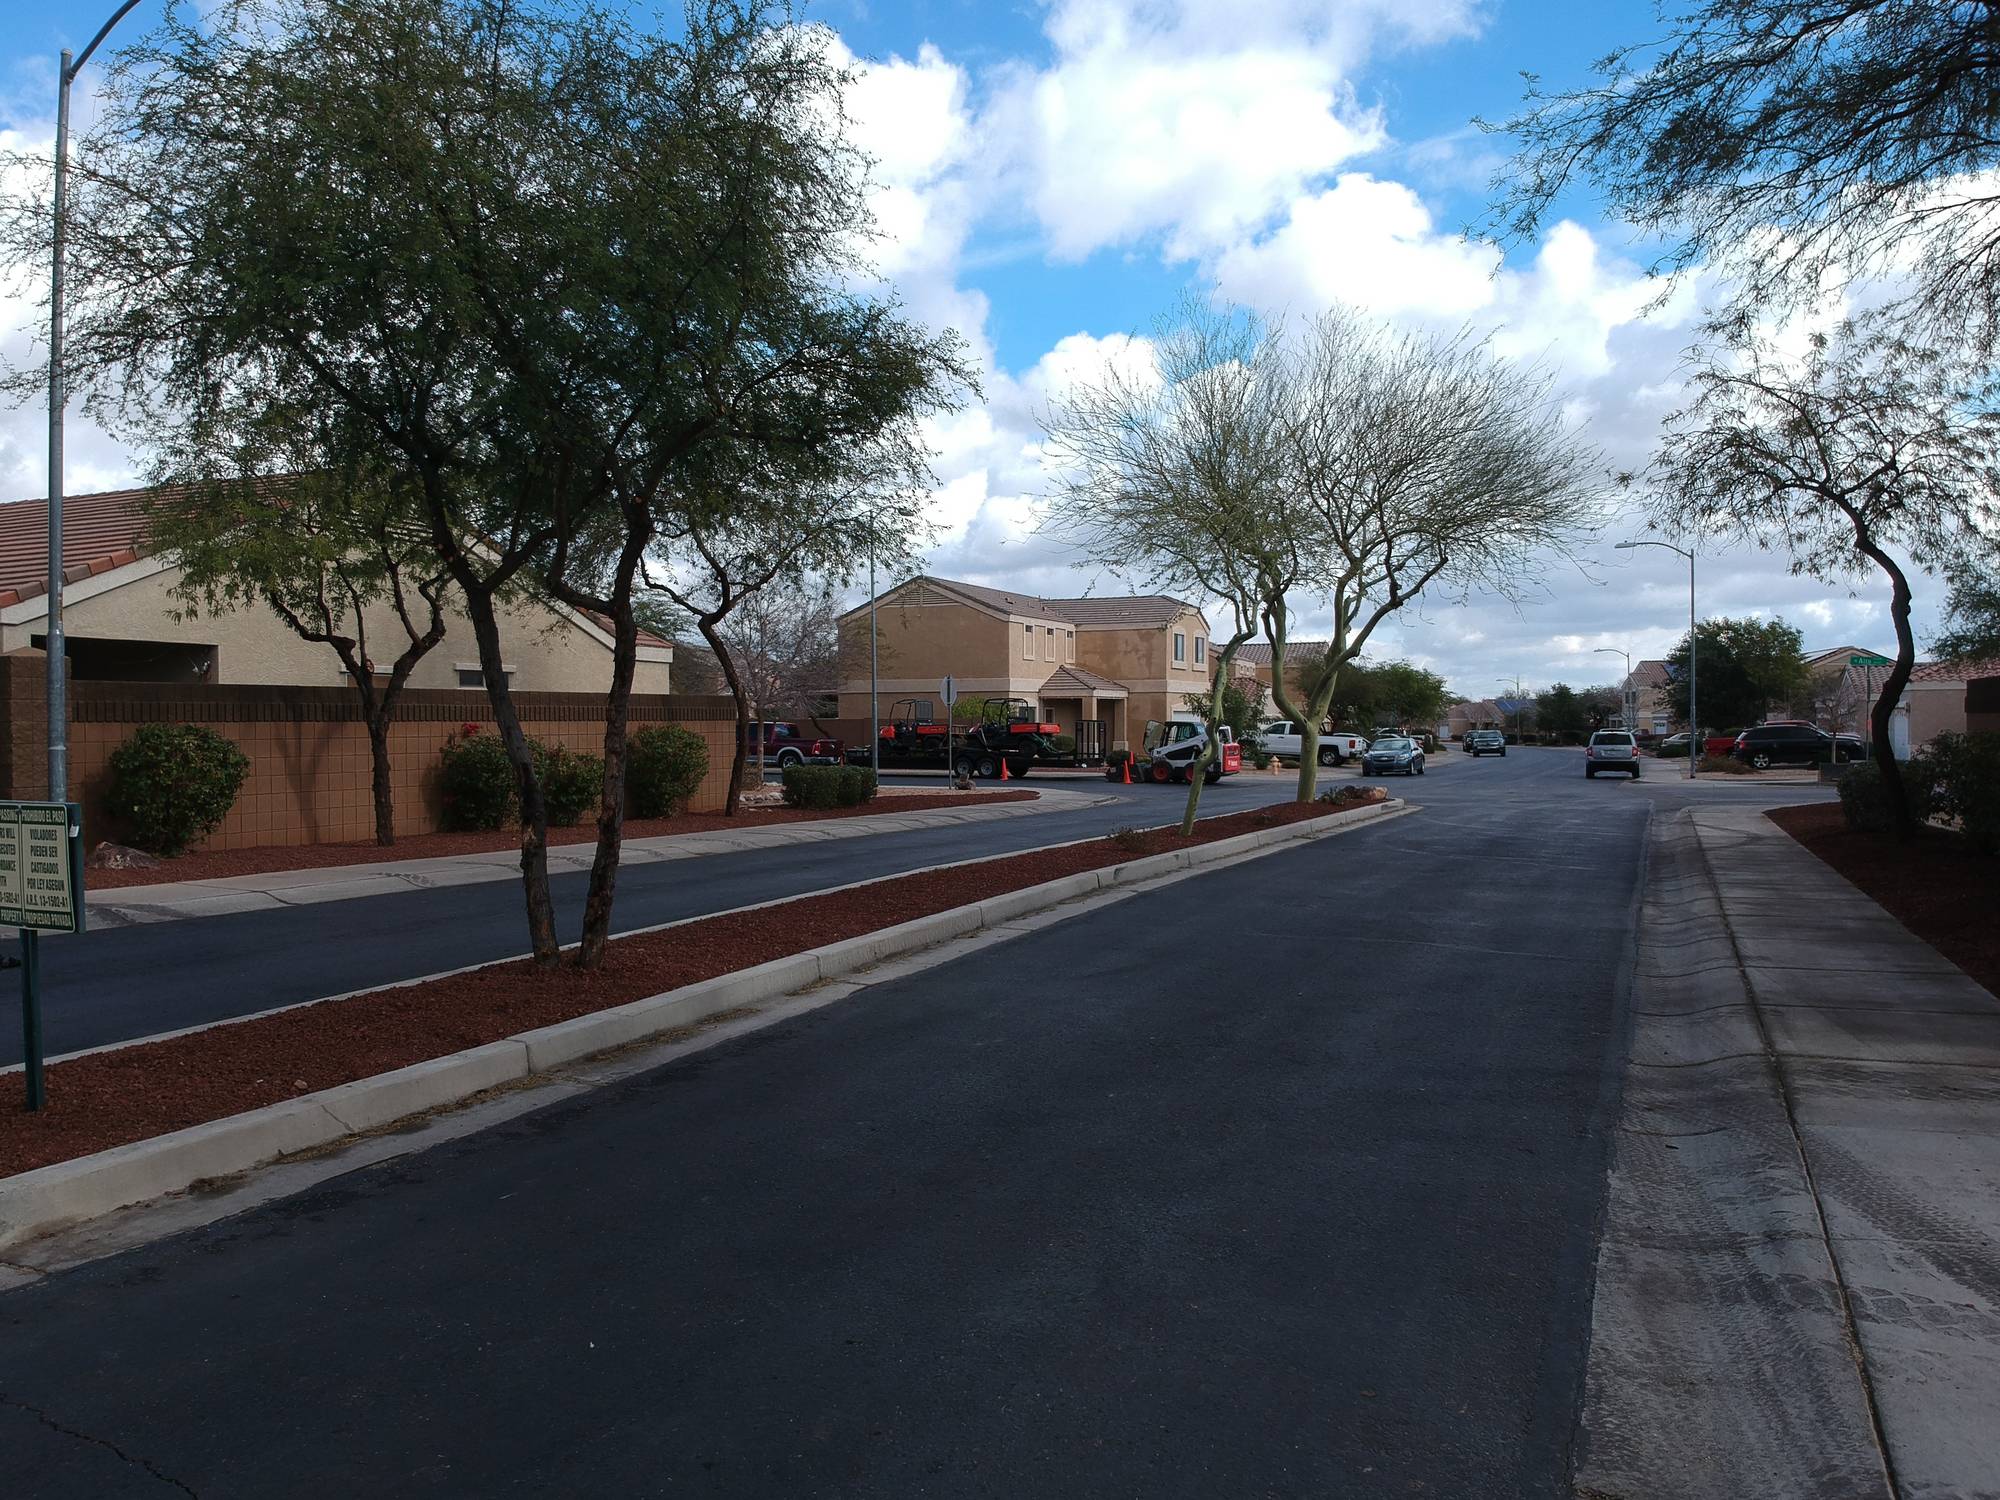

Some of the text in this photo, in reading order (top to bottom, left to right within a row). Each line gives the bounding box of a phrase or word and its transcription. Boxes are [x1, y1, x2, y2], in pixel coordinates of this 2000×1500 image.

[46, 810, 52, 822] EL
[52, 811, 65, 823] PASO
[30, 828, 58, 841] VIOLADORES
[31, 844, 59, 858] PUEDEN SER
[31, 861, 59, 875] CASTIGADOS
[27, 877, 36, 889] POR
[37, 878, 45, 890] LEY
[51, 913, 72, 927] PRIVADA
